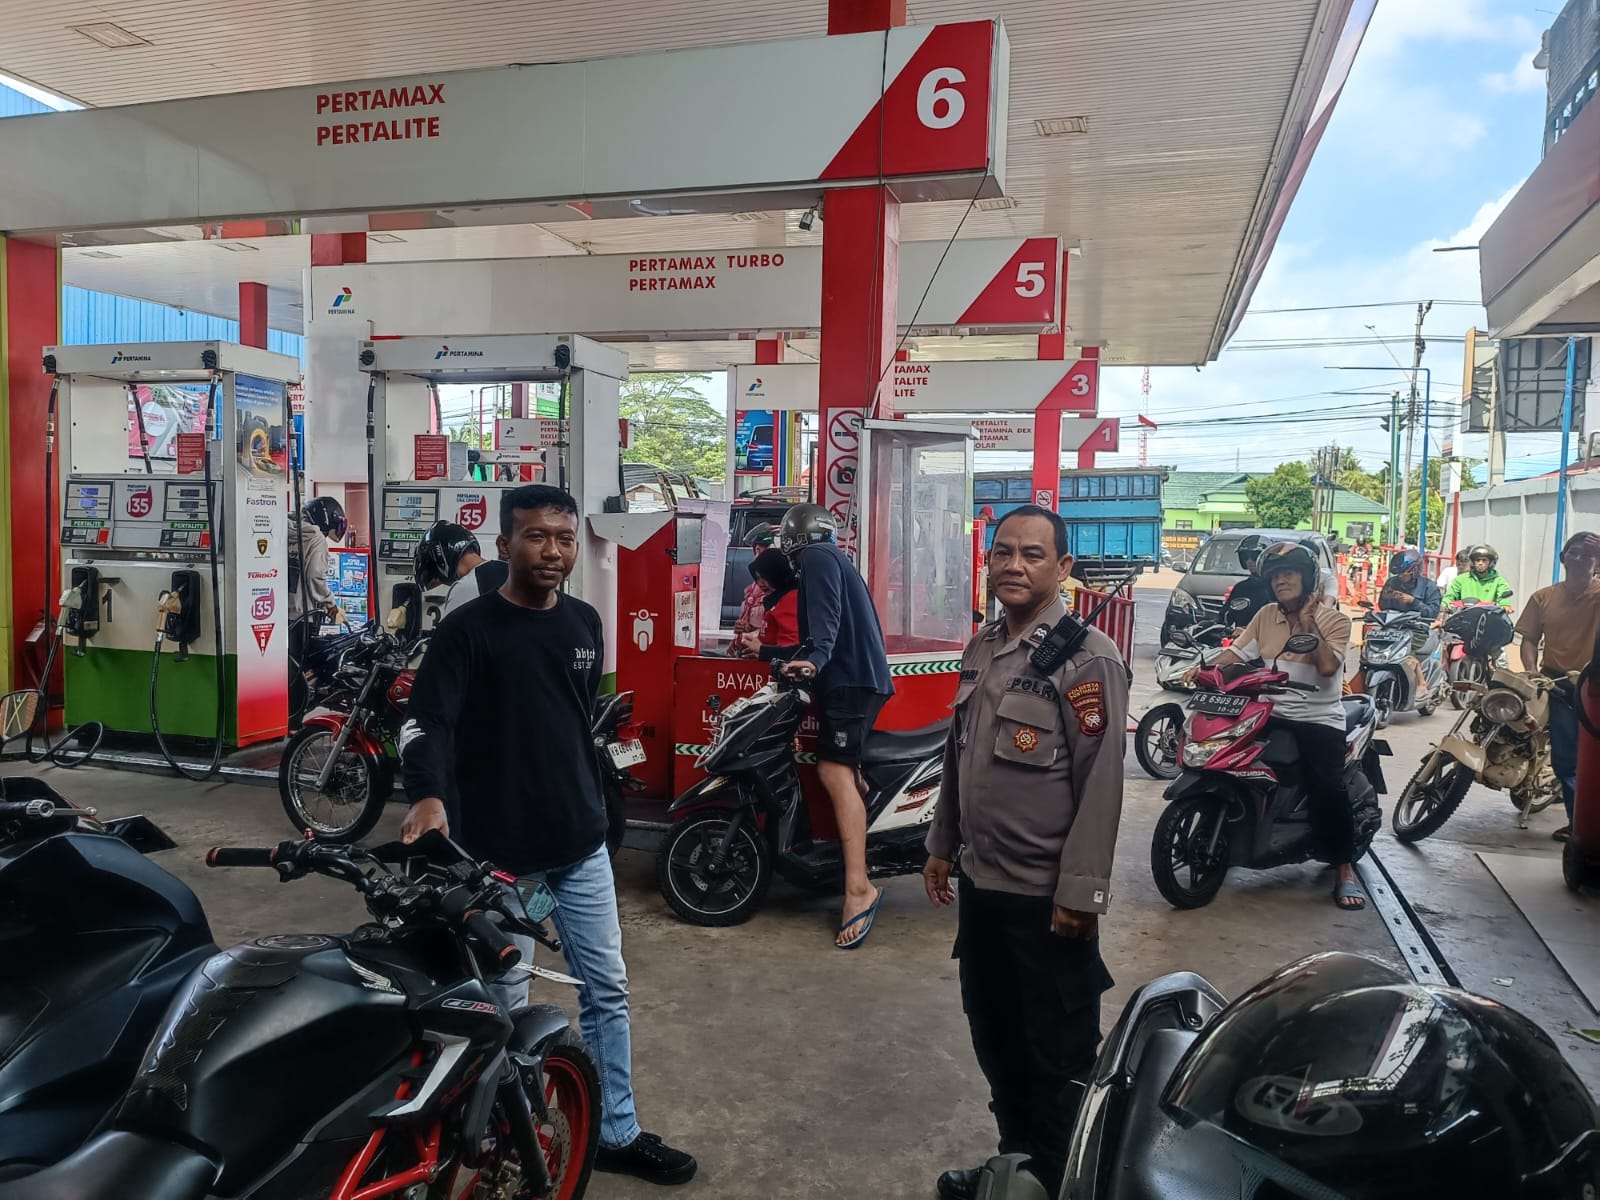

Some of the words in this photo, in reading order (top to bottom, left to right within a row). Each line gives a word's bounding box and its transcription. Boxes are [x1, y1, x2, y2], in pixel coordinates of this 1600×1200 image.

[316, 83, 446, 115] PERTAMAX
[916, 67, 967, 129] 6
[316, 116, 440, 146] PERTALITE
[629, 256, 716, 272] PERTAMAX
[727, 253, 785, 269] TURBO
[629, 276, 716, 292] PERTAMAX
[1014, 262, 1045, 298] 5
[894, 365, 931, 374] TAMAX
[894, 377, 929, 386] TALITE
[1071, 374, 1090, 396] 3
[1101, 427, 1111, 442] 1
[127, 498, 149, 513] 135
[246, 497, 277, 506] Fastron
[677, 611, 694, 620] Service
[717, 672, 763, 691] BAYAR
[1011, 677, 1056, 698] POLR
